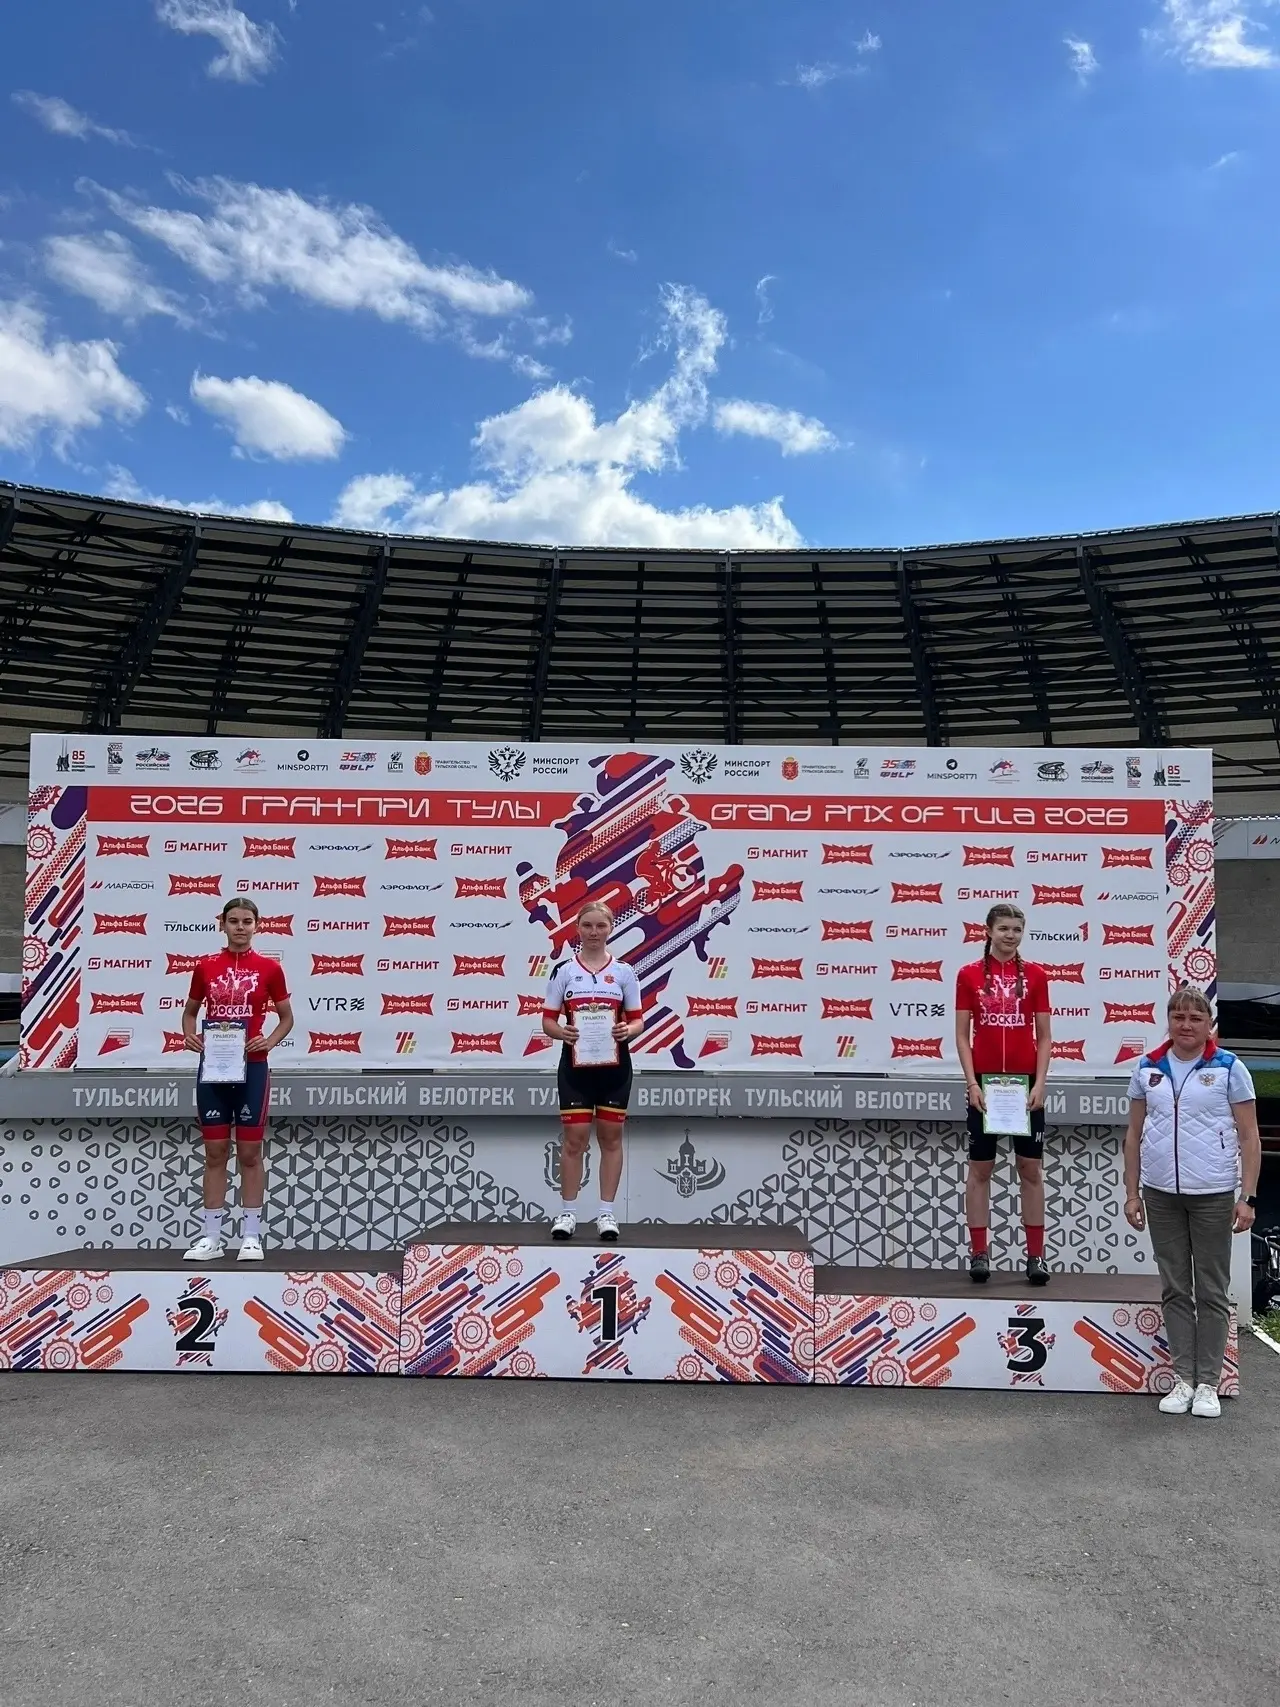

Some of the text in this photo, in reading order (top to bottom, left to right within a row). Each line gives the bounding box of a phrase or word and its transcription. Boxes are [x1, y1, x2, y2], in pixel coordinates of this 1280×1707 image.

[72, 751, 85, 760] 85
[533, 757, 580, 765] МИНСПОРТ
[724, 760, 771, 768] МИНСПОРТ
[1167, 765, 1180, 775] 85
[130, 795, 541, 819] 2026 ГРАН-ПРИ ТУЛЫ
[1044, 807, 1128, 826] 2026
[102, 841, 143, 850] Альфа Банк
[180, 843, 228, 852] МАГНИТ
[250, 842, 291, 852] Альфа Банк
[391, 844, 432, 854] Альфа Банк
[466, 846, 512, 855] МАГНИТ
[762, 849, 808, 858] МАГНИТ
[828, 849, 868, 858] Альфа Банк
[969, 851, 1009, 860] Альфа Банк
[1042, 853, 1088, 862] МАГНИТ
[1108, 853, 1147, 862] Альфа Банк
[104, 882, 154, 890] МАРАФОН
[174, 880, 216, 890] Альфа Банк
[252, 882, 300, 891] МАГНИТ
[319, 882, 361, 891] Альфа Банк
[461, 884, 501, 893] Альфа Банк
[758, 886, 798, 896] Альфа Банк
[897, 888, 937, 898] Альфа Банк
[973, 890, 1019, 899] МАГНИТ
[1038, 890, 1079, 900] Альфа Банк
[100, 919, 142, 928] Альфа Банк
[164, 922, 216, 932] ТУЛЬСКИЙ
[322, 921, 370, 930] МАГНИТ
[390, 922, 430, 931] Альфа Банк
[827, 926, 868, 936] Альфа Банк
[901, 927, 948, 937] МАГНИТ
[969, 929, 987, 938] Альф
[1109, 930, 1149, 939] Альфа Банк
[1029, 932, 1080, 941] ТУЛЬСКИЙ
[104, 959, 152, 969] МАГНИТ
[172, 960, 195, 970] Альфа
[317, 960, 358, 970] Альфа Банк
[392, 961, 440, 970] МАГНИТ
[459, 960, 499, 970] Альфа Банк
[757, 964, 798, 974] Альфа Банк
[831, 966, 878, 975] МАГНИТ
[897, 966, 937, 976] Альфа Банк
[1044, 968, 1079, 977] льфа Банк
[1114, 970, 1161, 979] МАГНИТ
[97, 999, 139, 1008] Альфа Банк
[308, 997, 347, 1011] VTR
[388, 1000, 428, 1010] Альфа Банк
[463, 1001, 509, 1010] МАГНИТ
[523, 1001, 544, 1011] Альф
[693, 1002, 732, 1012] Альфа Банк
[761, 1003, 808, 1012] МАГНИТ
[211, 1005, 251, 1016] МОСКВА
[828, 1004, 868, 1014] Альфа Банк
[890, 1003, 928, 1017] VTR
[1050, 1008, 1090, 1017] АГНИТ
[1110, 1008, 1150, 1018] Альфа Банк
[981, 1013, 1025, 1025] МОСКВА
[169, 1037, 185, 1047] Аль
[315, 1038, 357, 1047] Альфа Банк
[457, 1038, 498, 1048] Альфа Банк
[757, 1040, 797, 1050] Альфа Банк
[897, 1043, 938, 1052] Альфа Банк
[1062, 1045, 1080, 1053] Банк
[73, 1082, 179, 1107] ТУЛЬСКИЙ
[305, 1081, 407, 1106] ТУЛЬСКИЙ
[419, 1087, 515, 1106] ВЕЛОТРЕК
[638, 1084, 952, 1110] ВЕЛОТРЕК ТУЛЬСКИЙ ВЕЛОТРЕК
[1079, 1095, 1131, 1115] ВЕЛО
[591, 1286, 618, 1342] 1
[175, 1297, 216, 1352] 2
[1006, 1318, 1048, 1373] 3
